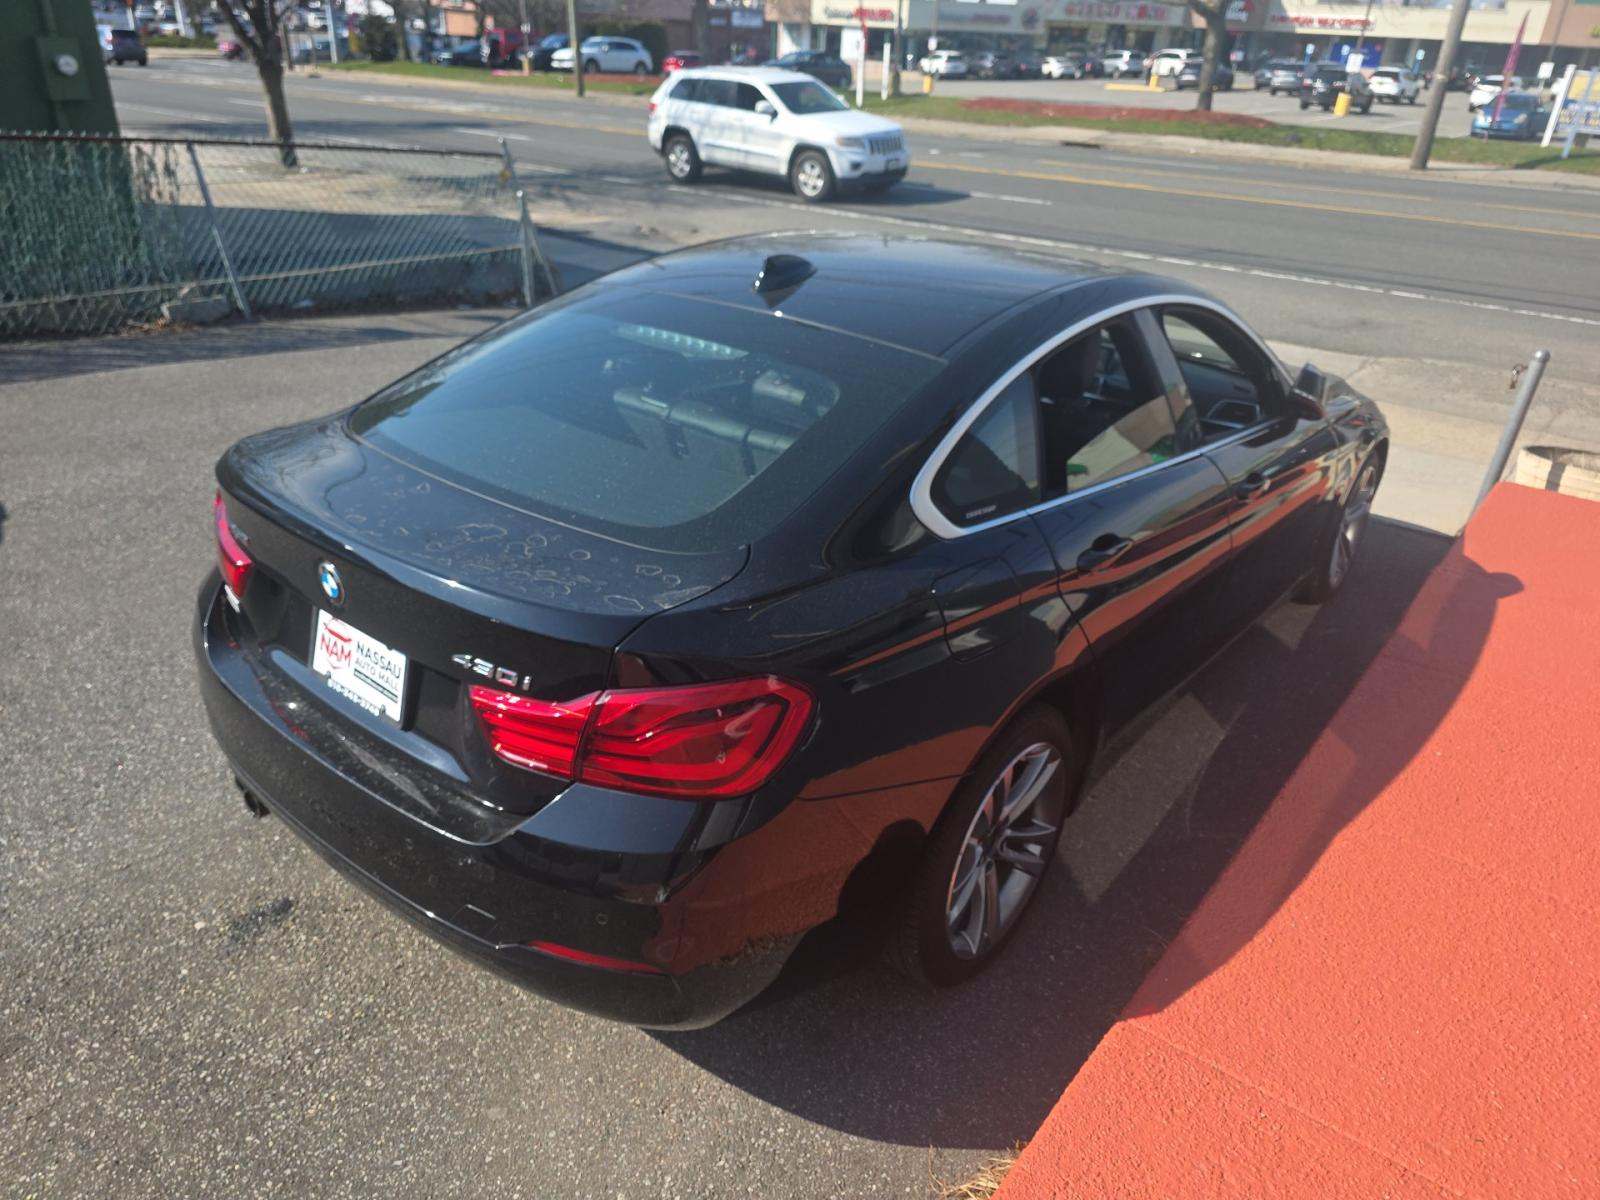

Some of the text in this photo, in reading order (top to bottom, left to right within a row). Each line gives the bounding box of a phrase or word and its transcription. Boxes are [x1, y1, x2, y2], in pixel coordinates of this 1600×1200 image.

[320, 634, 352, 668] NAM
[356, 641, 402, 679] NASSAU
[355, 657, 376, 675] AUTO
[378, 670, 399, 691] MALL
